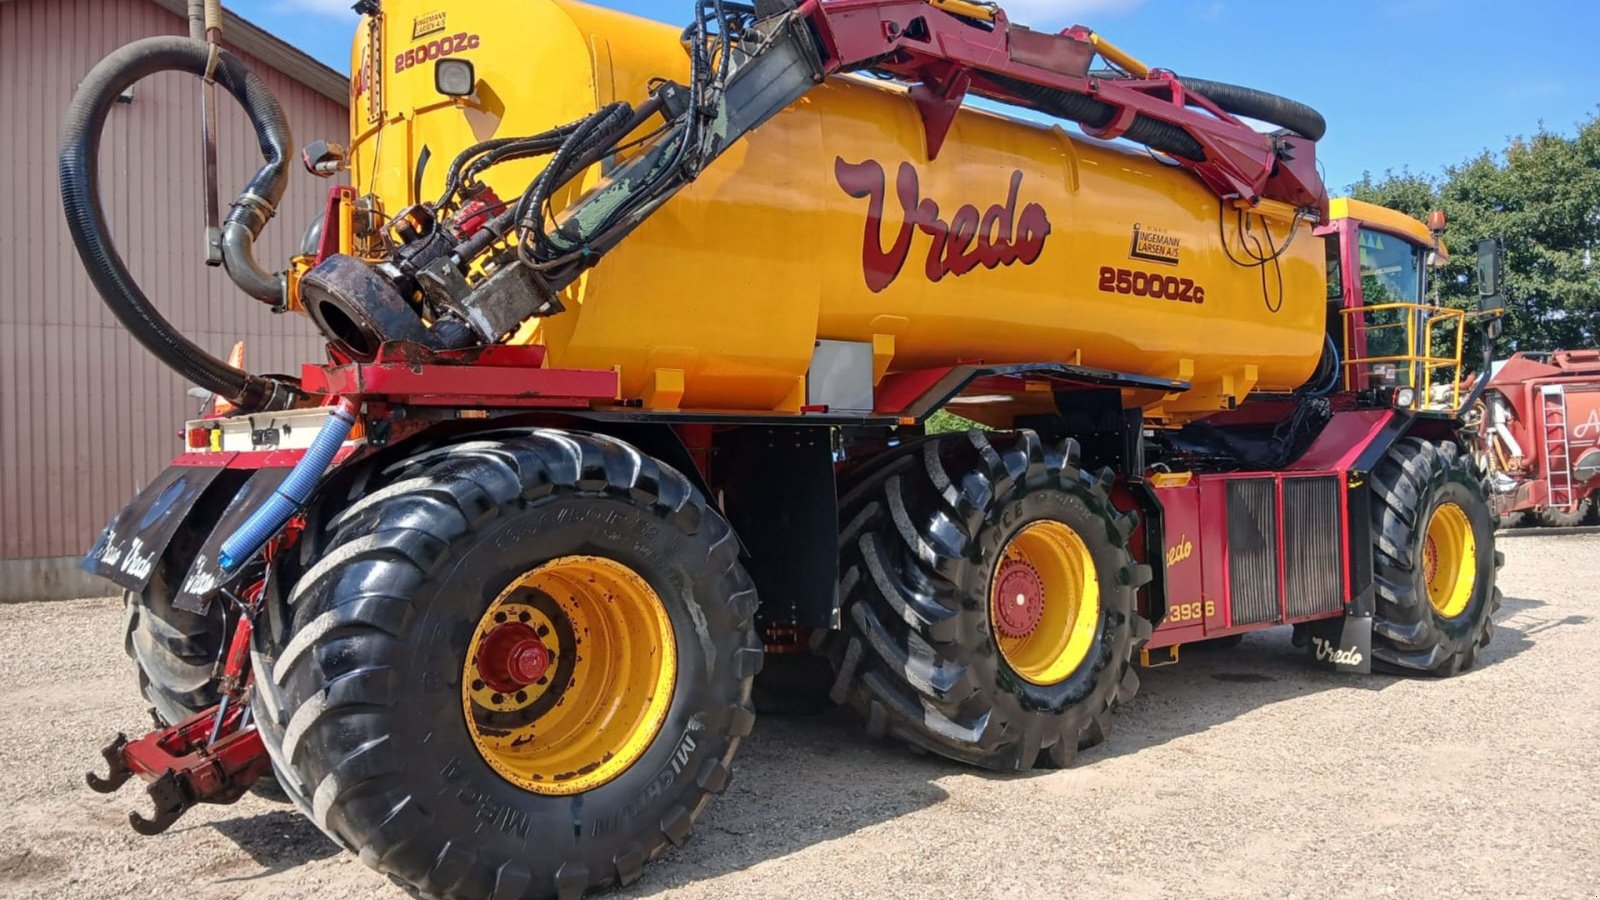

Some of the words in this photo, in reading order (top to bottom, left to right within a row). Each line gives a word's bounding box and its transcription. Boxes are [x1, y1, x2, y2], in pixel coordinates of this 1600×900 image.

[395, 32, 480, 73] 25000Zc
[835, 156, 1051, 293] Vredo
[1139, 231, 1180, 247] INGEMANN
[1138, 242, 1166, 255] LARSEN
[1099, 266, 1205, 304] 25000Zc
[1312, 636, 1363, 665] Vredo
